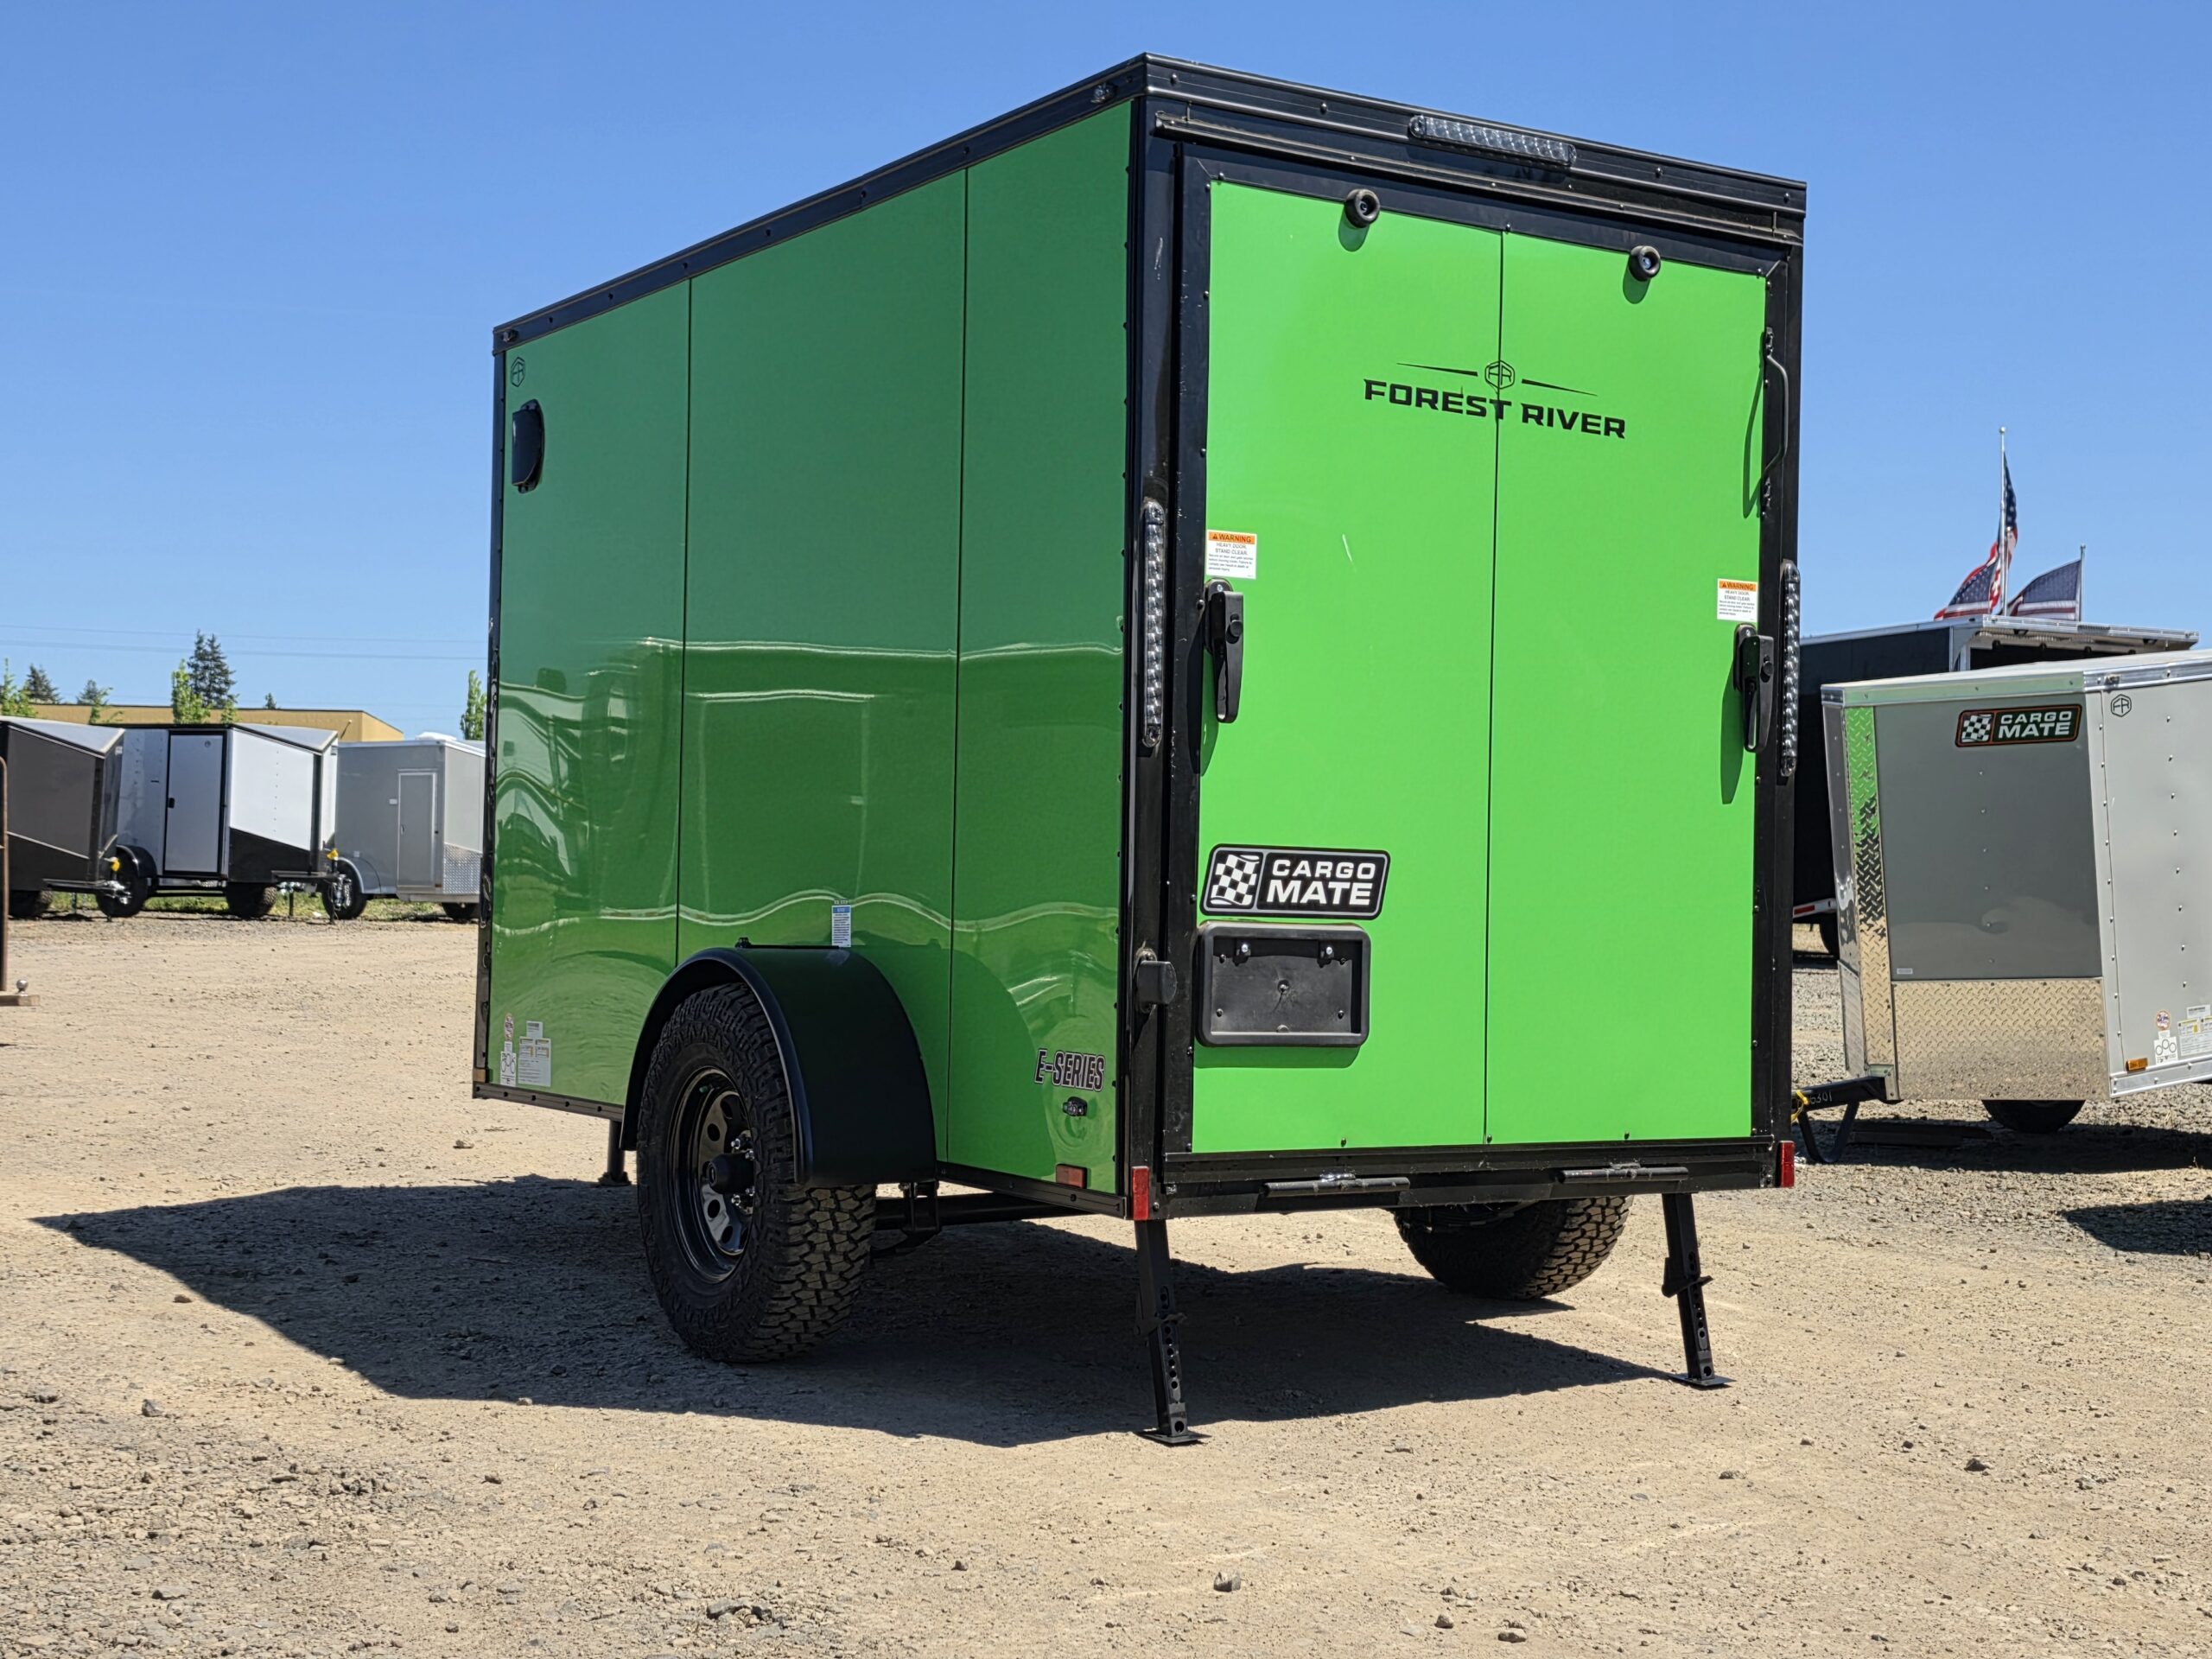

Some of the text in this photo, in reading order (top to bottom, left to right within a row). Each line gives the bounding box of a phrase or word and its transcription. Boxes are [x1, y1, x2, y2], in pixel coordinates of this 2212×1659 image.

[1363, 378, 1625, 439] FOREST RIVER
[1219, 533, 1251, 543] WARNING
[1726, 581, 1753, 591] WARNING
[2000, 710, 2072, 724] CARGO
[1998, 721, 2071, 739] MATE
[1272, 859, 1376, 880] CARGO
[1266, 879, 1374, 906] MATE
[1034, 1048, 1105, 1092] E-SERIES
